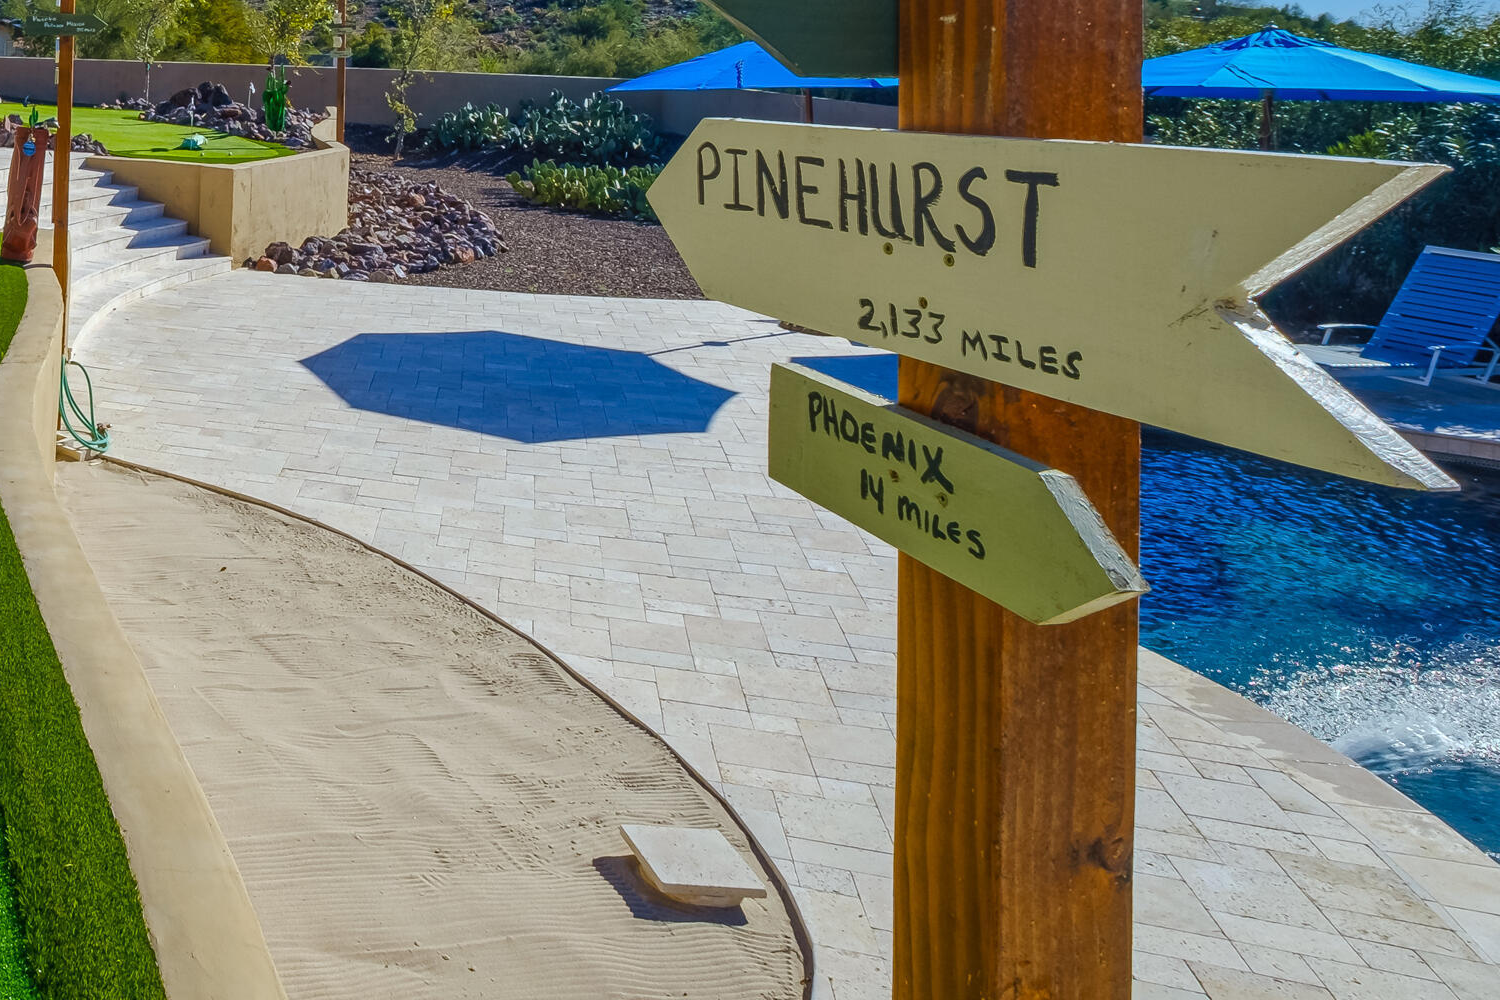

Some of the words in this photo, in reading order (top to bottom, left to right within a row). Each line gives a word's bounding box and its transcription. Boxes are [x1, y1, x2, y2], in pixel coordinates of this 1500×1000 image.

[696, 141, 1060, 268] PINEHURST
[857, 298, 946, 344] 2,133
[961, 328, 1084, 380] MILES
[807, 390, 954, 494] PHOENIX
[859, 468, 885, 514] 14
[897, 494, 986, 560] MILES
